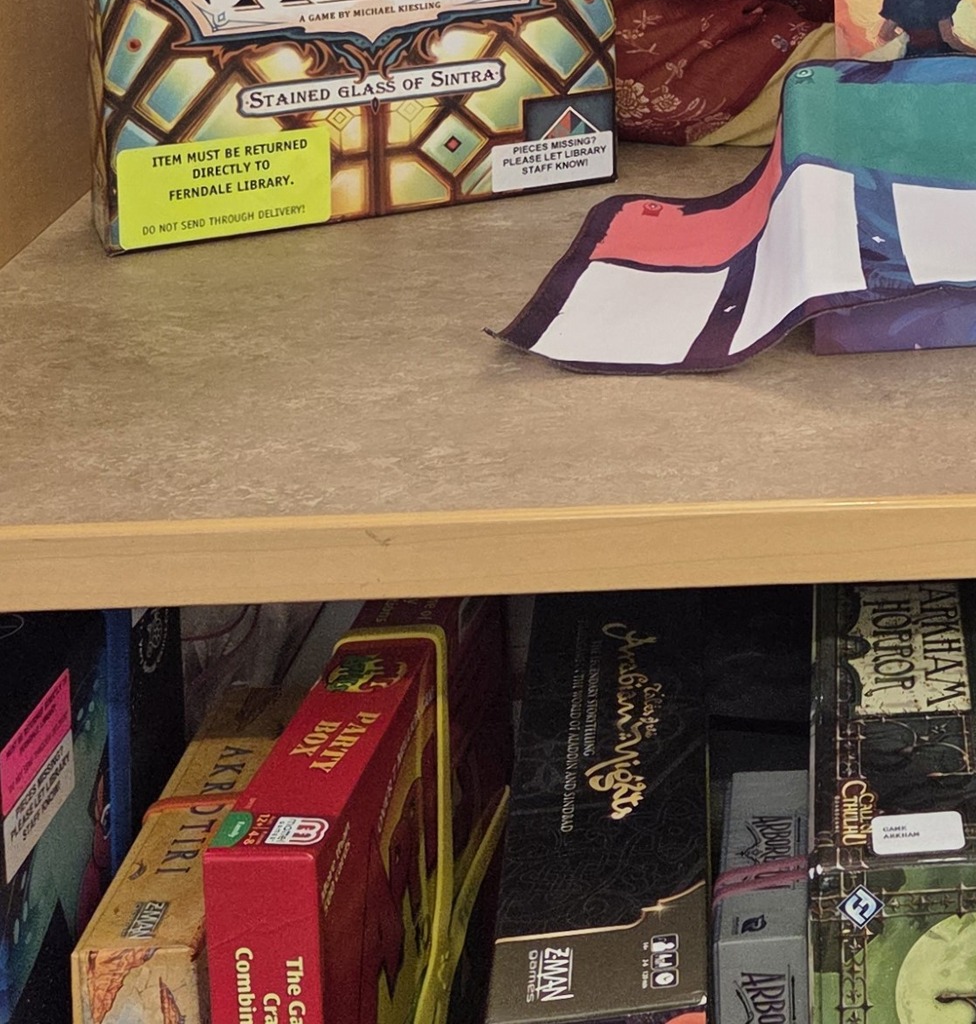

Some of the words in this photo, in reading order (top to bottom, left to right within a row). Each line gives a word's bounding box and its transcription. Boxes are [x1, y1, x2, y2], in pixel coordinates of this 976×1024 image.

[308, 11, 336, 22] GAME
[338, 10, 350, 19] BY
[352, 6, 396, 18] MICHAEL
[398, 1, 442, 13] KIESLING
[250, 87, 332, 110] STAINED
[336, 80, 397, 100] GLASS
[402, 76, 424, 92] OF
[430, 68, 496, 88] SINTRA
[152, 153, 182, 168] ITEM
[186, 149, 221, 164] MUST
[224, 146, 241, 160] BE
[244, 138, 308, 156] RETURNED
[502, 154, 542, 168] PLEASE
[544, 150, 563, 163] LET
[564, 144, 607, 161] LIBRARY
[512, 141, 549, 156] PIECES
[550, 134, 598, 151] MISSING?
[192, 162, 251, 180] DIRECTLY
[254, 160, 270, 171] TO
[522, 163, 552, 176] STAFF
[554, 158, 589, 172] KNOW!
[169, 182, 233, 202] FERNDALE
[237, 174, 294, 192] LIBRARY.
[142, 224, 156, 236] DO
[158, 222, 178, 234] NOT
[180, 218, 206, 230] SEND
[209, 212, 255, 227] THROUGH
[258, 204, 306, 220] DELIVERY!
[862, 598, 917, 698] HORROR
[919, 585, 967, 708] ARKHAM
[289, 719, 342, 758] BOX
[308, 710, 382, 774] PARTY
[564, 732, 578, 769] ALADDIN
[563, 772, 577, 790] AND
[560, 792, 576, 833] SINDBAD
[285, 956, 304, 996] The
